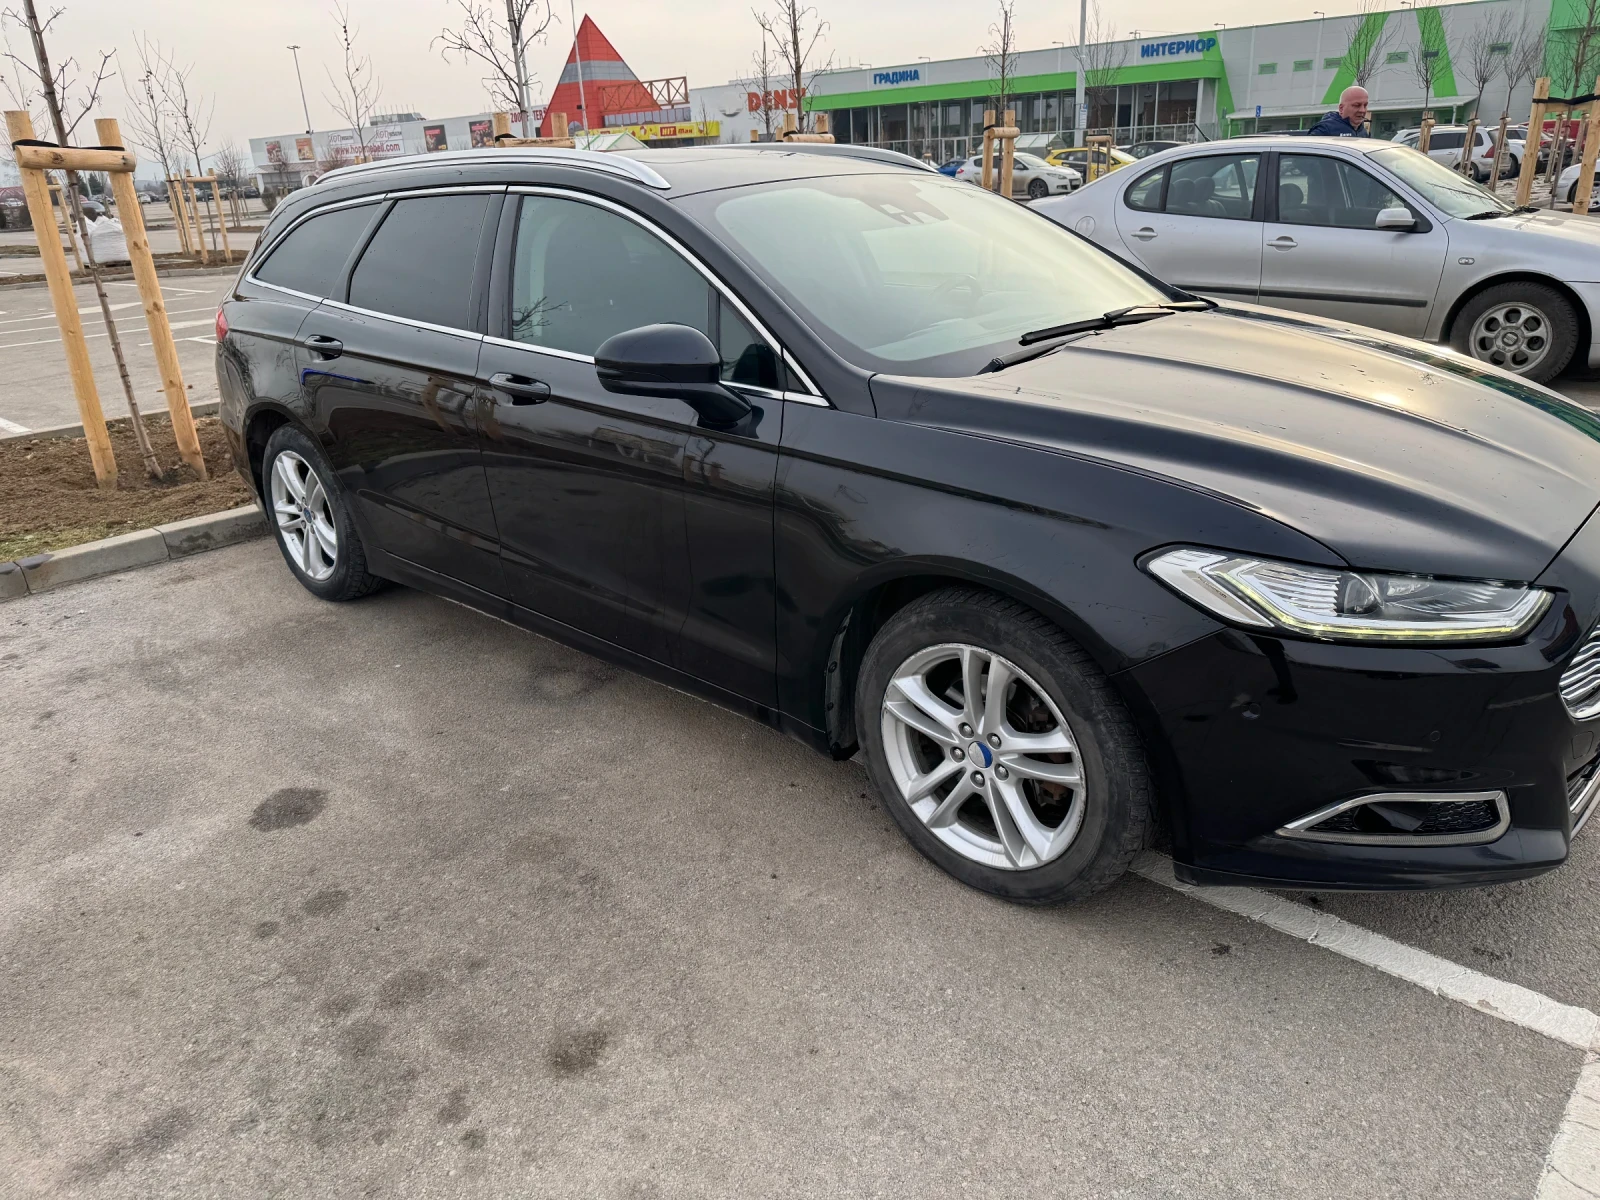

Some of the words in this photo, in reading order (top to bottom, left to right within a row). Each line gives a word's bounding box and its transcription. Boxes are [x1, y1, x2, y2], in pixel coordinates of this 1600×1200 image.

[1141, 37, 1216, 58] ИНТЕРИОР
[873, 69, 920, 85] ГРАДИНА
[662, 127, 675, 136] HIT
